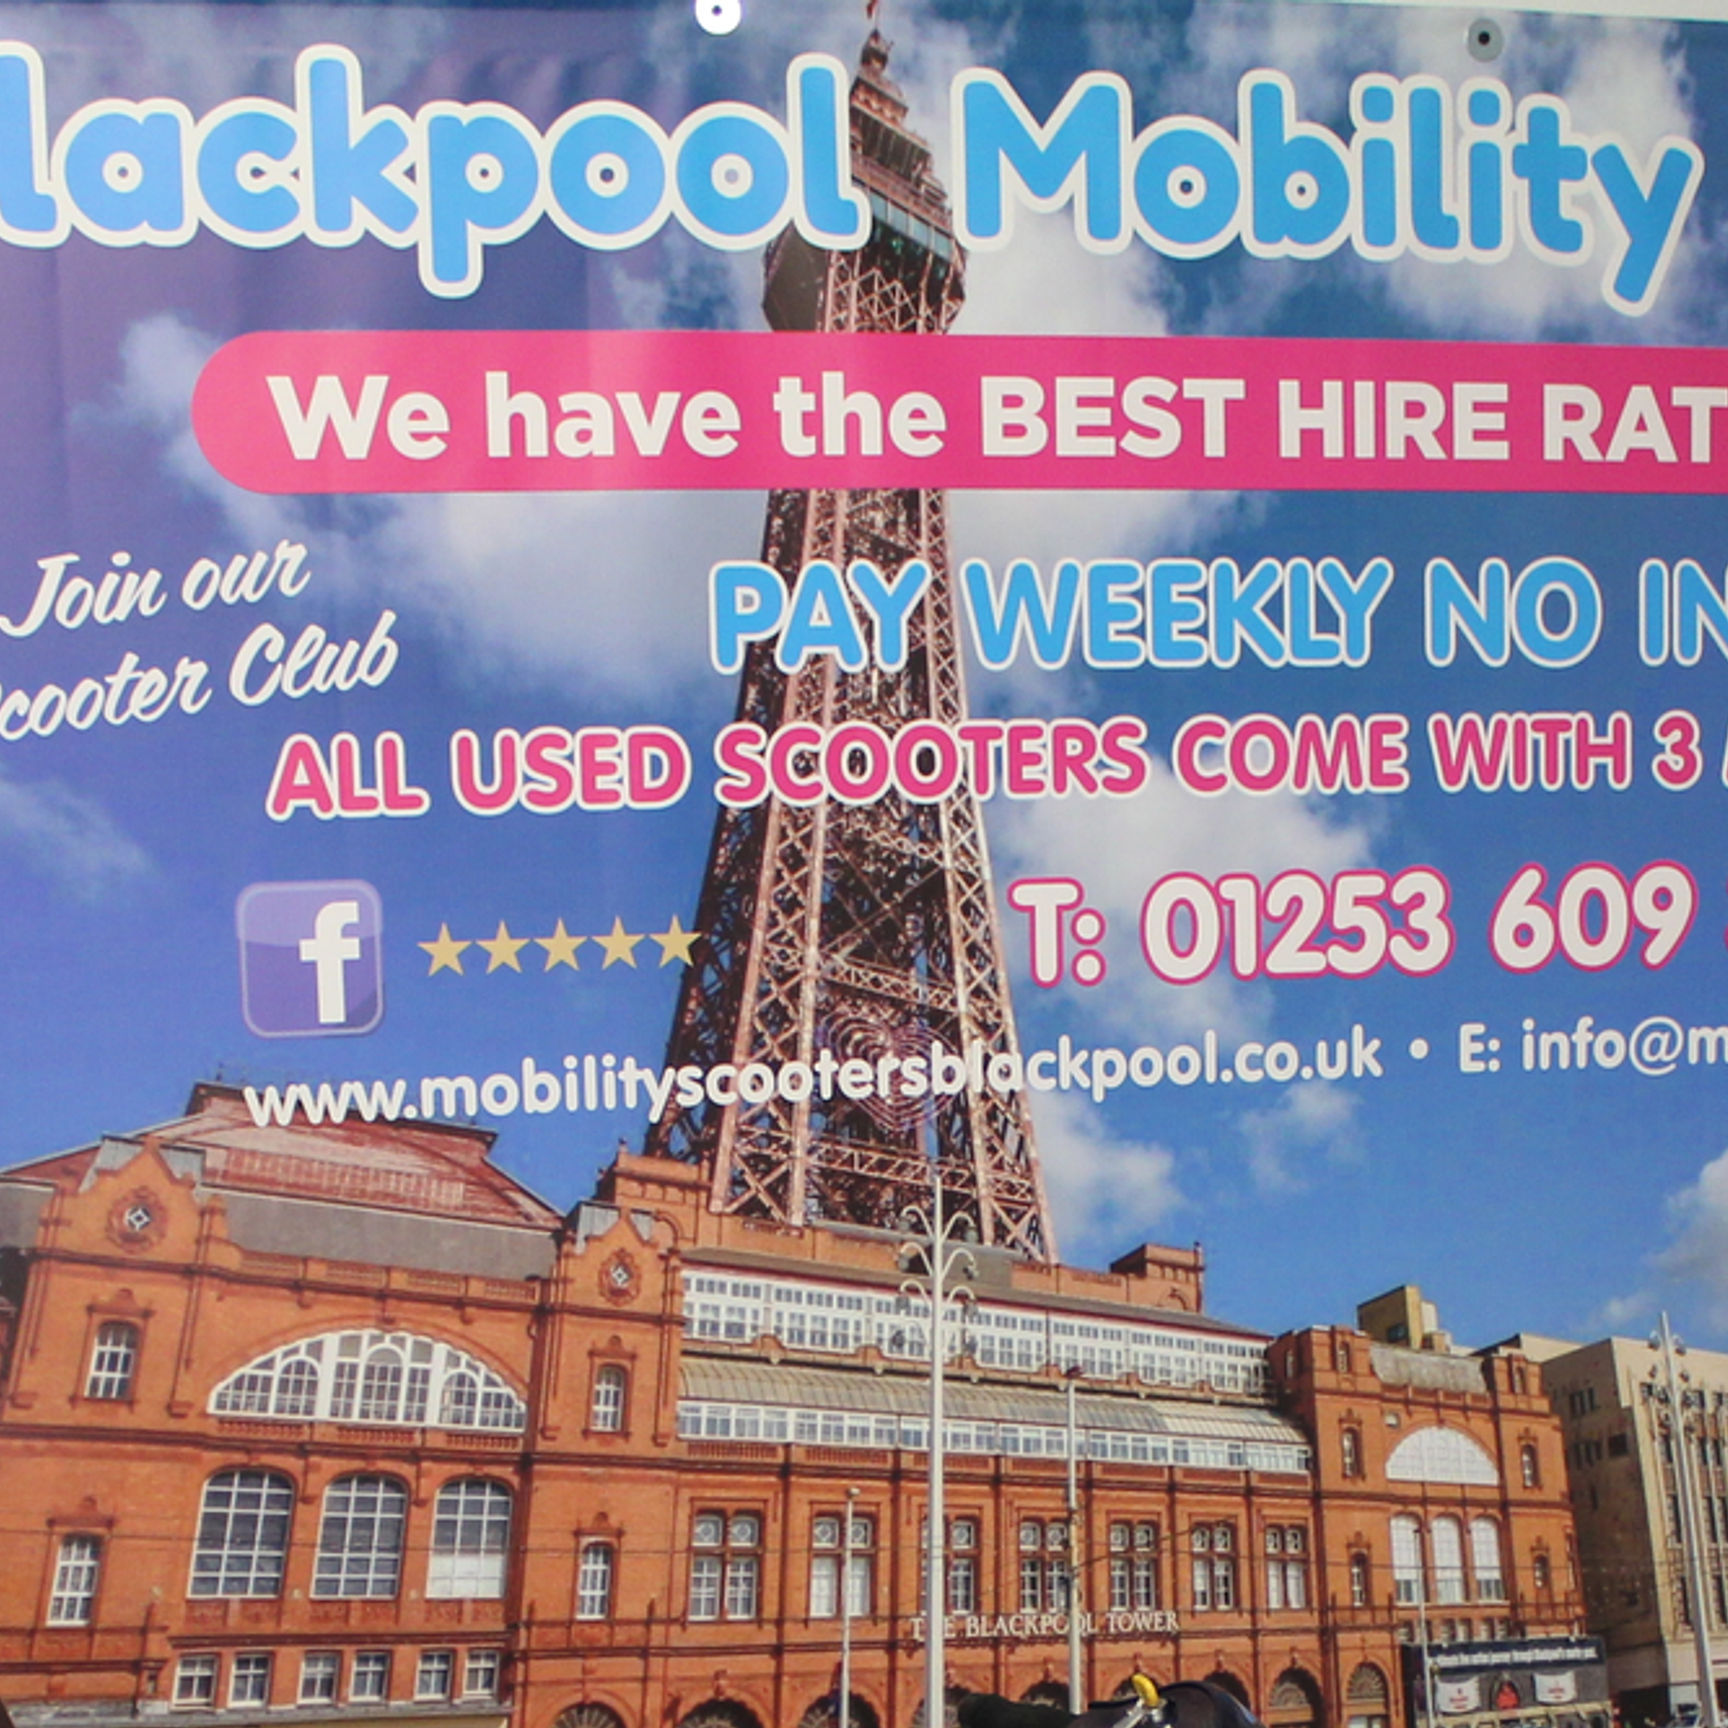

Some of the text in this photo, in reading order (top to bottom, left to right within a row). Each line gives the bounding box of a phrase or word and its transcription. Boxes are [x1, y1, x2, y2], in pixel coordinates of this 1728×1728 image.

[951, 67, 1704, 316] Mobility
[266, 374, 449, 459] We
[485, 372, 741, 459] have
[773, 371, 946, 458] the
[979, 376, 1245, 458] BEST
[1279, 379, 1510, 461] HIRE
[182, 539, 311, 610] our
[709, 559, 932, 675] PAY
[960, 556, 1394, 669] WEEKLY
[1424, 556, 1602, 668] NO
[229, 609, 399, 706] Club
[269, 731, 429, 820] ALL
[450, 725, 690, 812] USED
[713, 719, 1150, 809] SCOOTERS
[1170, 713, 1409, 797] COME
[1427, 712, 1631, 790] WITH
[1651, 711, 1701, 790] 3
[299, 901, 360, 1023] f
[1009, 877, 1106, 988] T:
[1141, 868, 1453, 982] 01253
[1488, 860, 1699, 974] 609
[244, 1022, 1383, 1128] www.mobilityscootersblackpool.co.uk
[1459, 1022, 1501, 1072] E:
[909, 1612, 957, 1642] TE
[1106, 1609, 1180, 1634] TOWER
